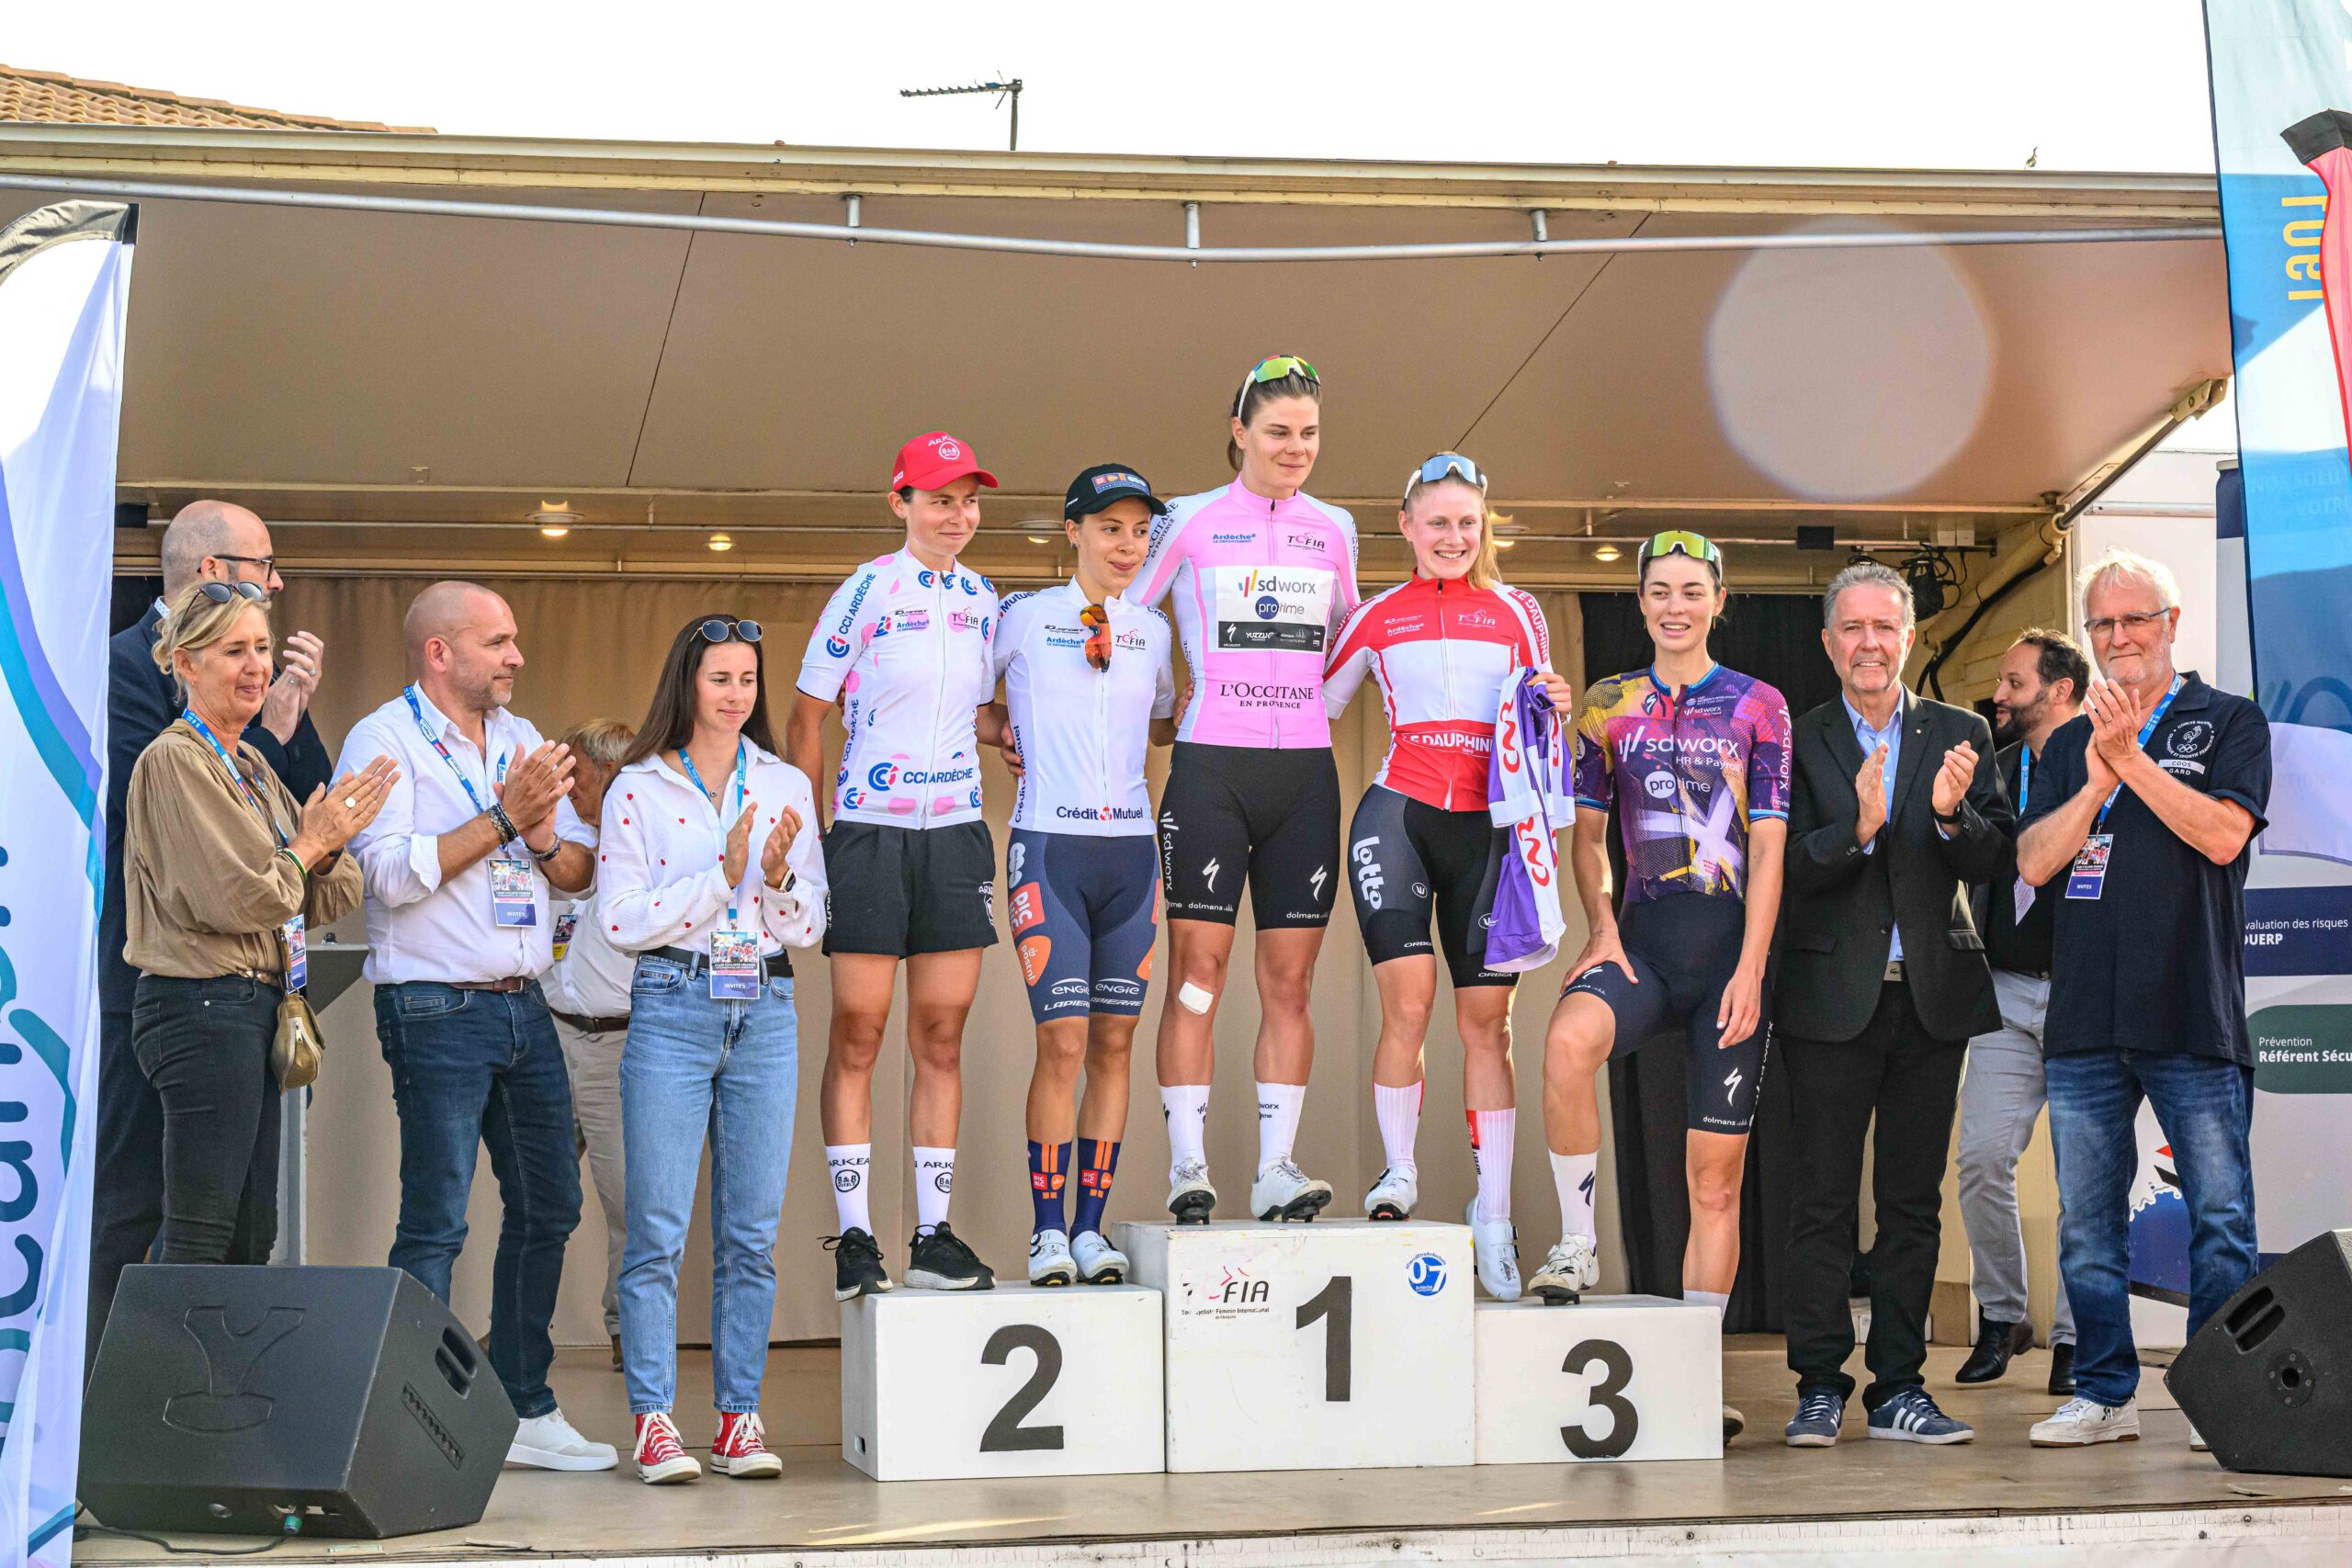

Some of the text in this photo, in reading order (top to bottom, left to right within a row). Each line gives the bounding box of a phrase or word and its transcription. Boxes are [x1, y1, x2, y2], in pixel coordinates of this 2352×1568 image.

[838, 572, 876, 635] CCI ARDÈCHE
[896, 621, 927, 629] Ardèche
[1046, 637, 1081, 645] Ardèche
[1421, 733, 1495, 753] DAUPHIN
[1676, 756, 1740, 773] HR & Payroll
[902, 768, 974, 784] CCI ARDÈCHE
[2168, 768, 2192, 776] GARD
[1057, 807, 1144, 820] Crédit Mutuel
[1189, 902, 1223, 911] dolmans
[2245, 919, 2349, 931] valuation des risques
[2259, 1036, 2312, 1047] Prévention
[2259, 1050, 2319, 1063] Référent
[1702, 1116, 1736, 1126] dolmans
[1296, 1276, 1351, 1402] 1
[980, 1325, 1064, 1452] 2
[1560, 1338, 1639, 1460] 3
